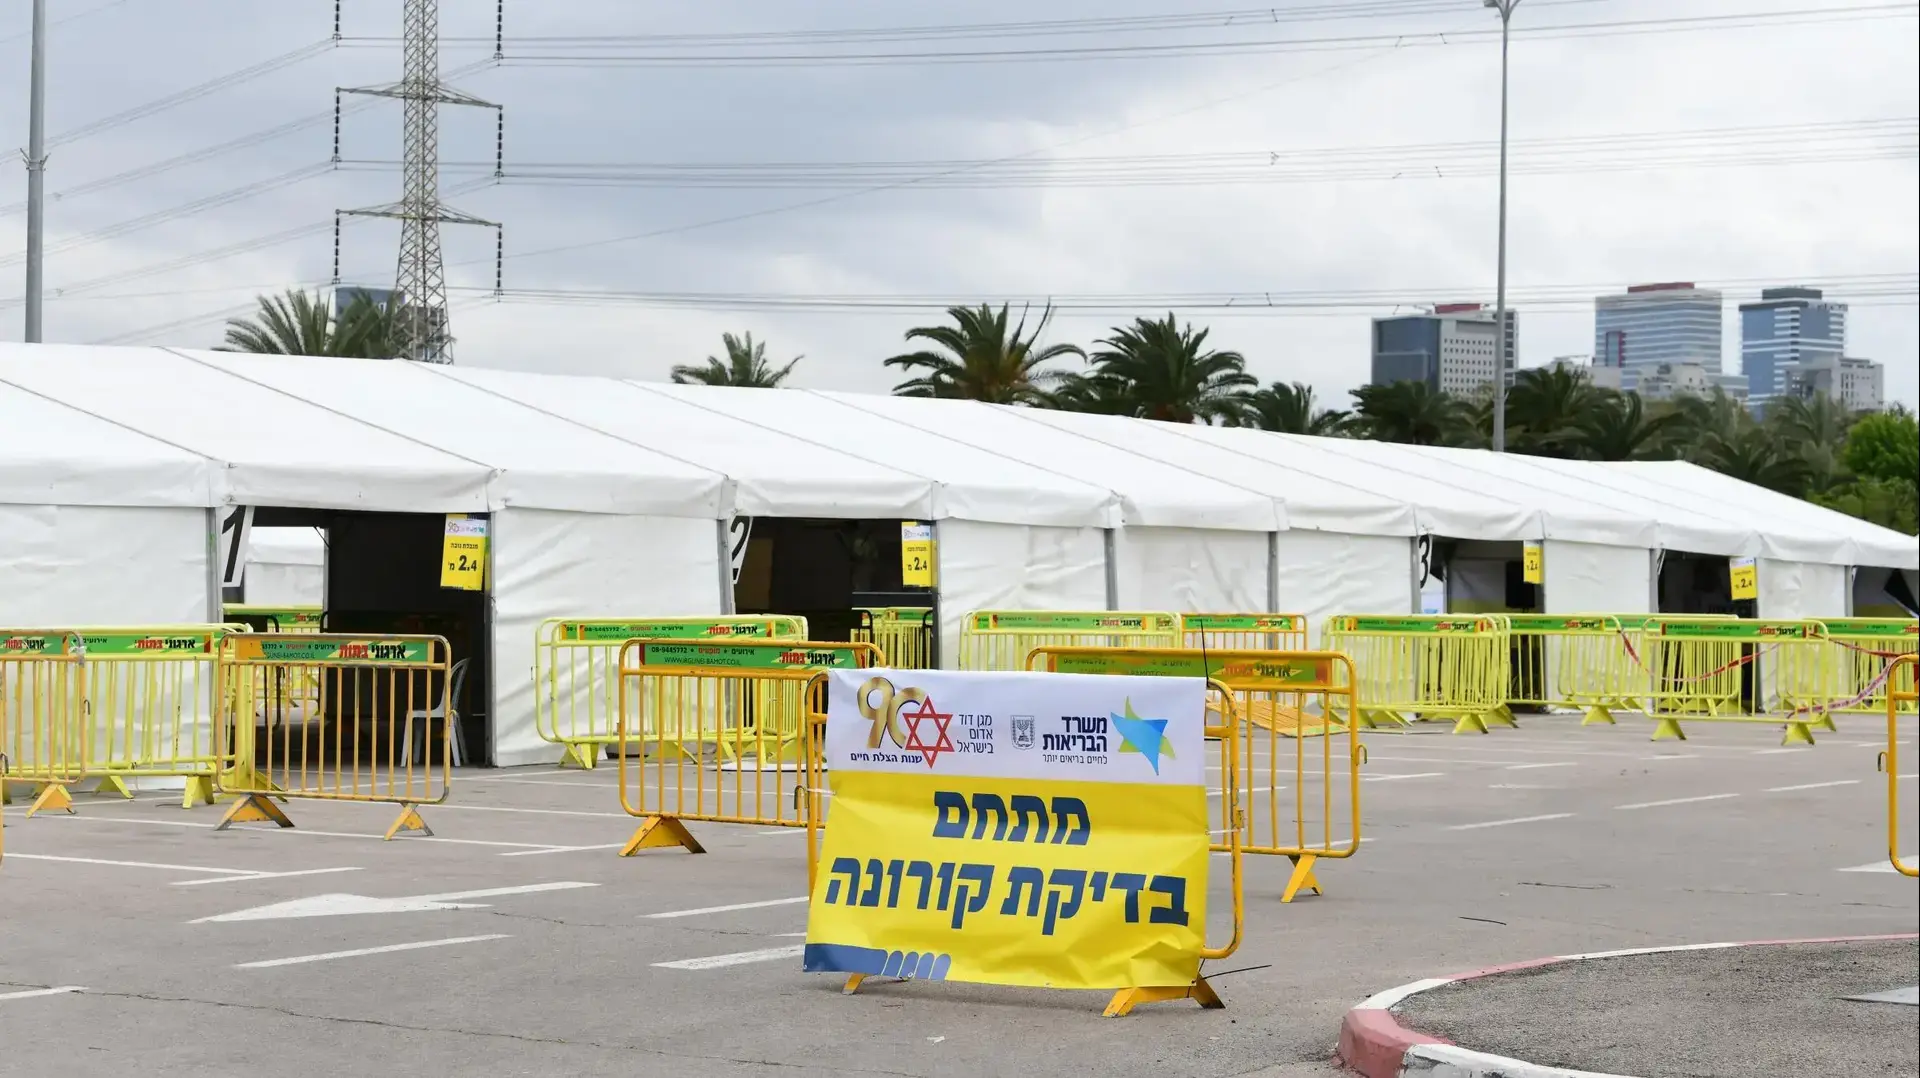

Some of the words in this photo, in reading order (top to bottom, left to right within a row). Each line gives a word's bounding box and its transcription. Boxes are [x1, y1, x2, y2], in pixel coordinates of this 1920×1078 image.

[222, 505, 246, 582] 1
[458, 554, 477, 571] 2.4
[914, 556, 928, 571] 2.4
[732, 625, 758, 635] ארגוני
[165, 639, 196, 649] ארגוני
[370, 644, 406, 659] ארגוני
[807, 652, 836, 665] ארגוני
[958, 714, 974, 725] דוד
[977, 714, 993, 728] מגן
[1061, 716, 1108, 734] משרד
[969, 728, 993, 740] אדום
[956, 739, 994, 754] בישראל
[1042, 733, 1108, 752] הבריאות
[850, 752, 869, 761] חיים
[873, 752, 898, 762] הצלת
[901, 754, 923, 763] שנות
[1042, 754, 1058, 763] יותר
[1060, 754, 1085, 764] בריאים
[1086, 754, 1108, 765] לחיים
[932, 791, 1091, 846] מתחם
[825, 857, 994, 930] קורונה
[1000, 866, 1190, 936] בדיקת
